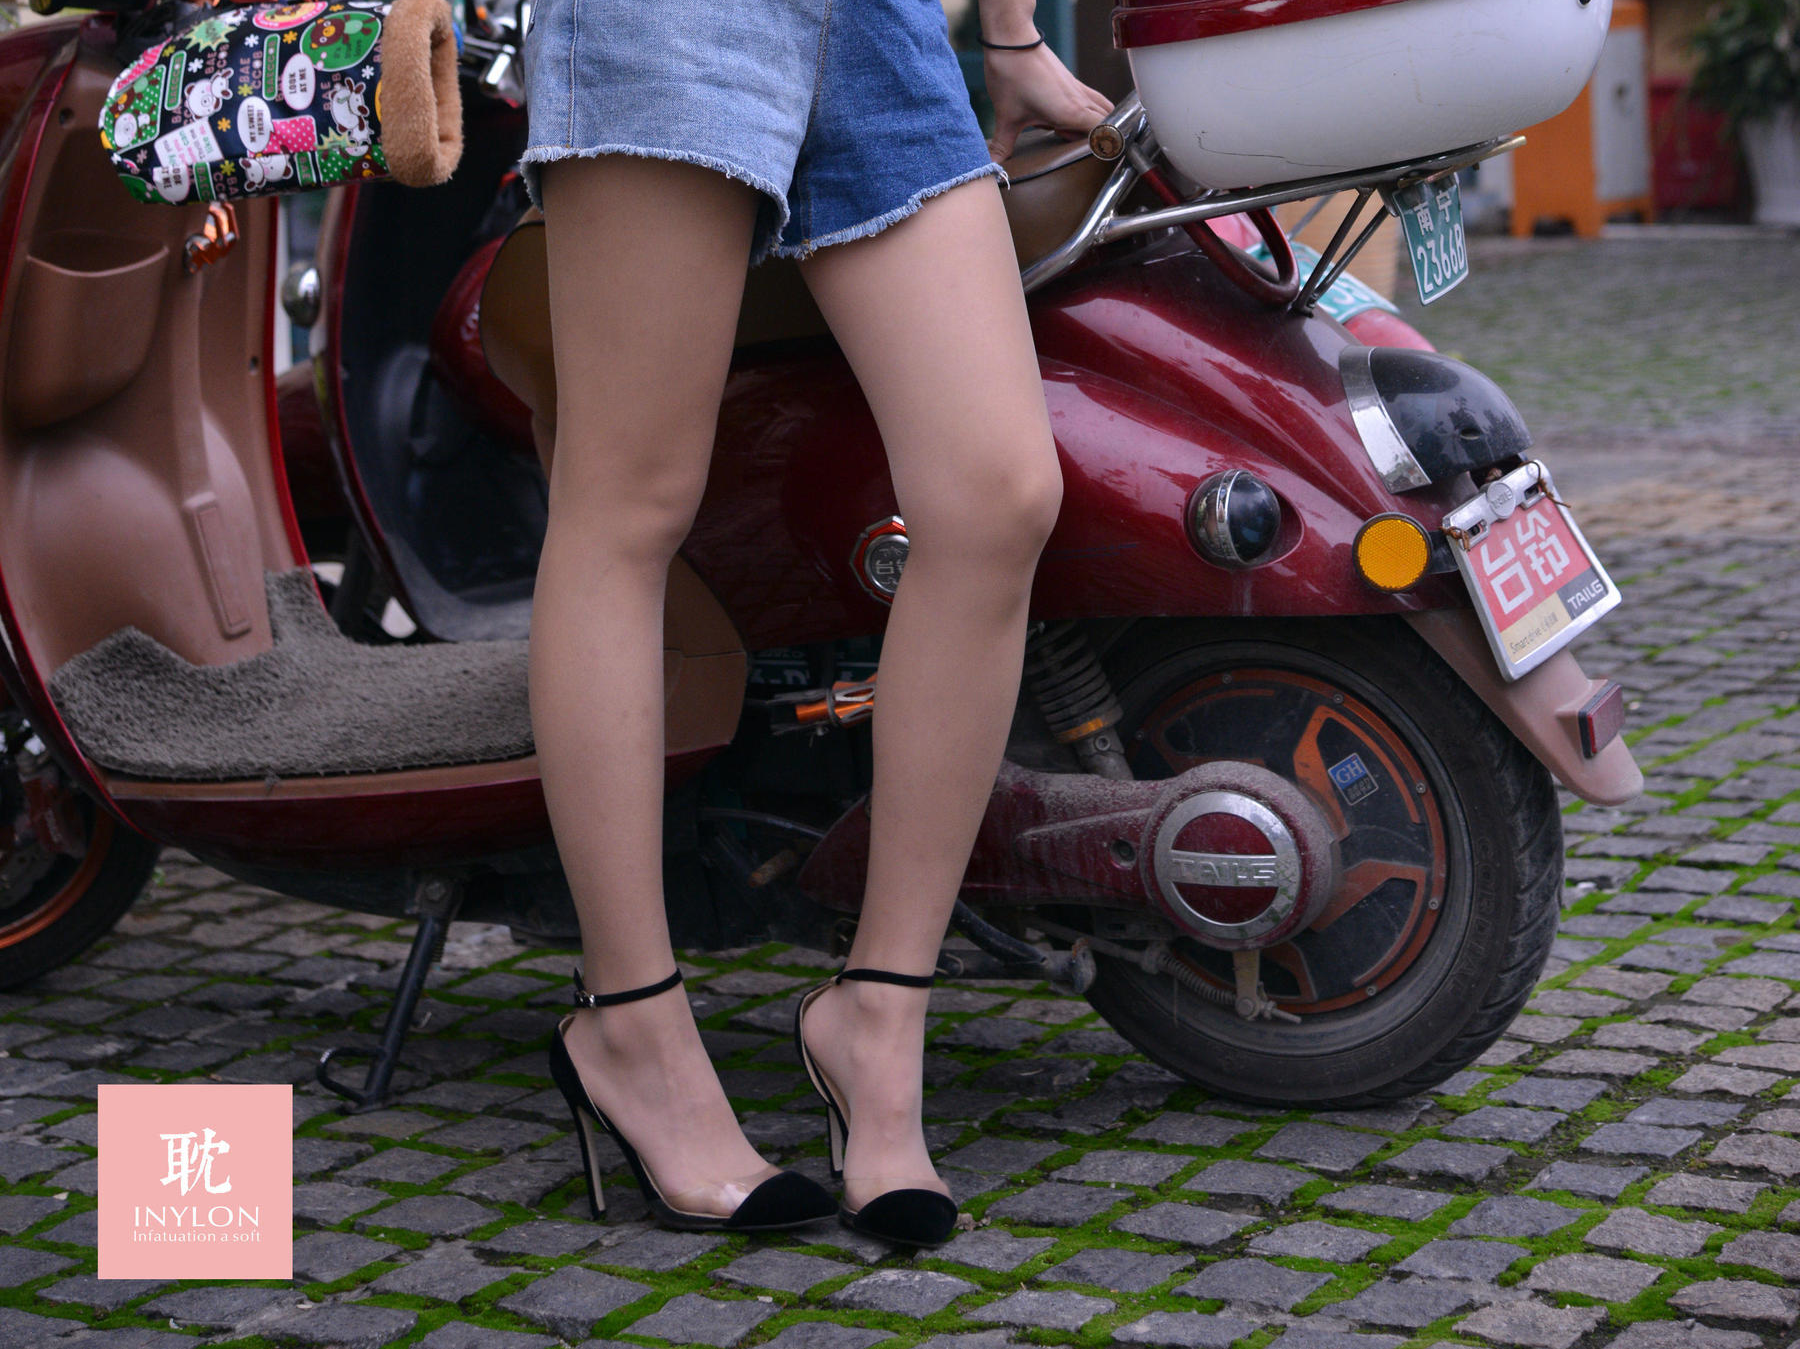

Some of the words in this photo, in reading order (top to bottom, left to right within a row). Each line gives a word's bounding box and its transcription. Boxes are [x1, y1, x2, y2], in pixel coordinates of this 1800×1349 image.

[288, 72, 297, 94] LOOK
[298, 68, 307, 80] ME
[299, 83, 307, 93] AT
[1413, 190, 1453, 236] 南宁
[1567, 578, 1604, 610] TAILG
[1335, 761, 1366, 785] GH
